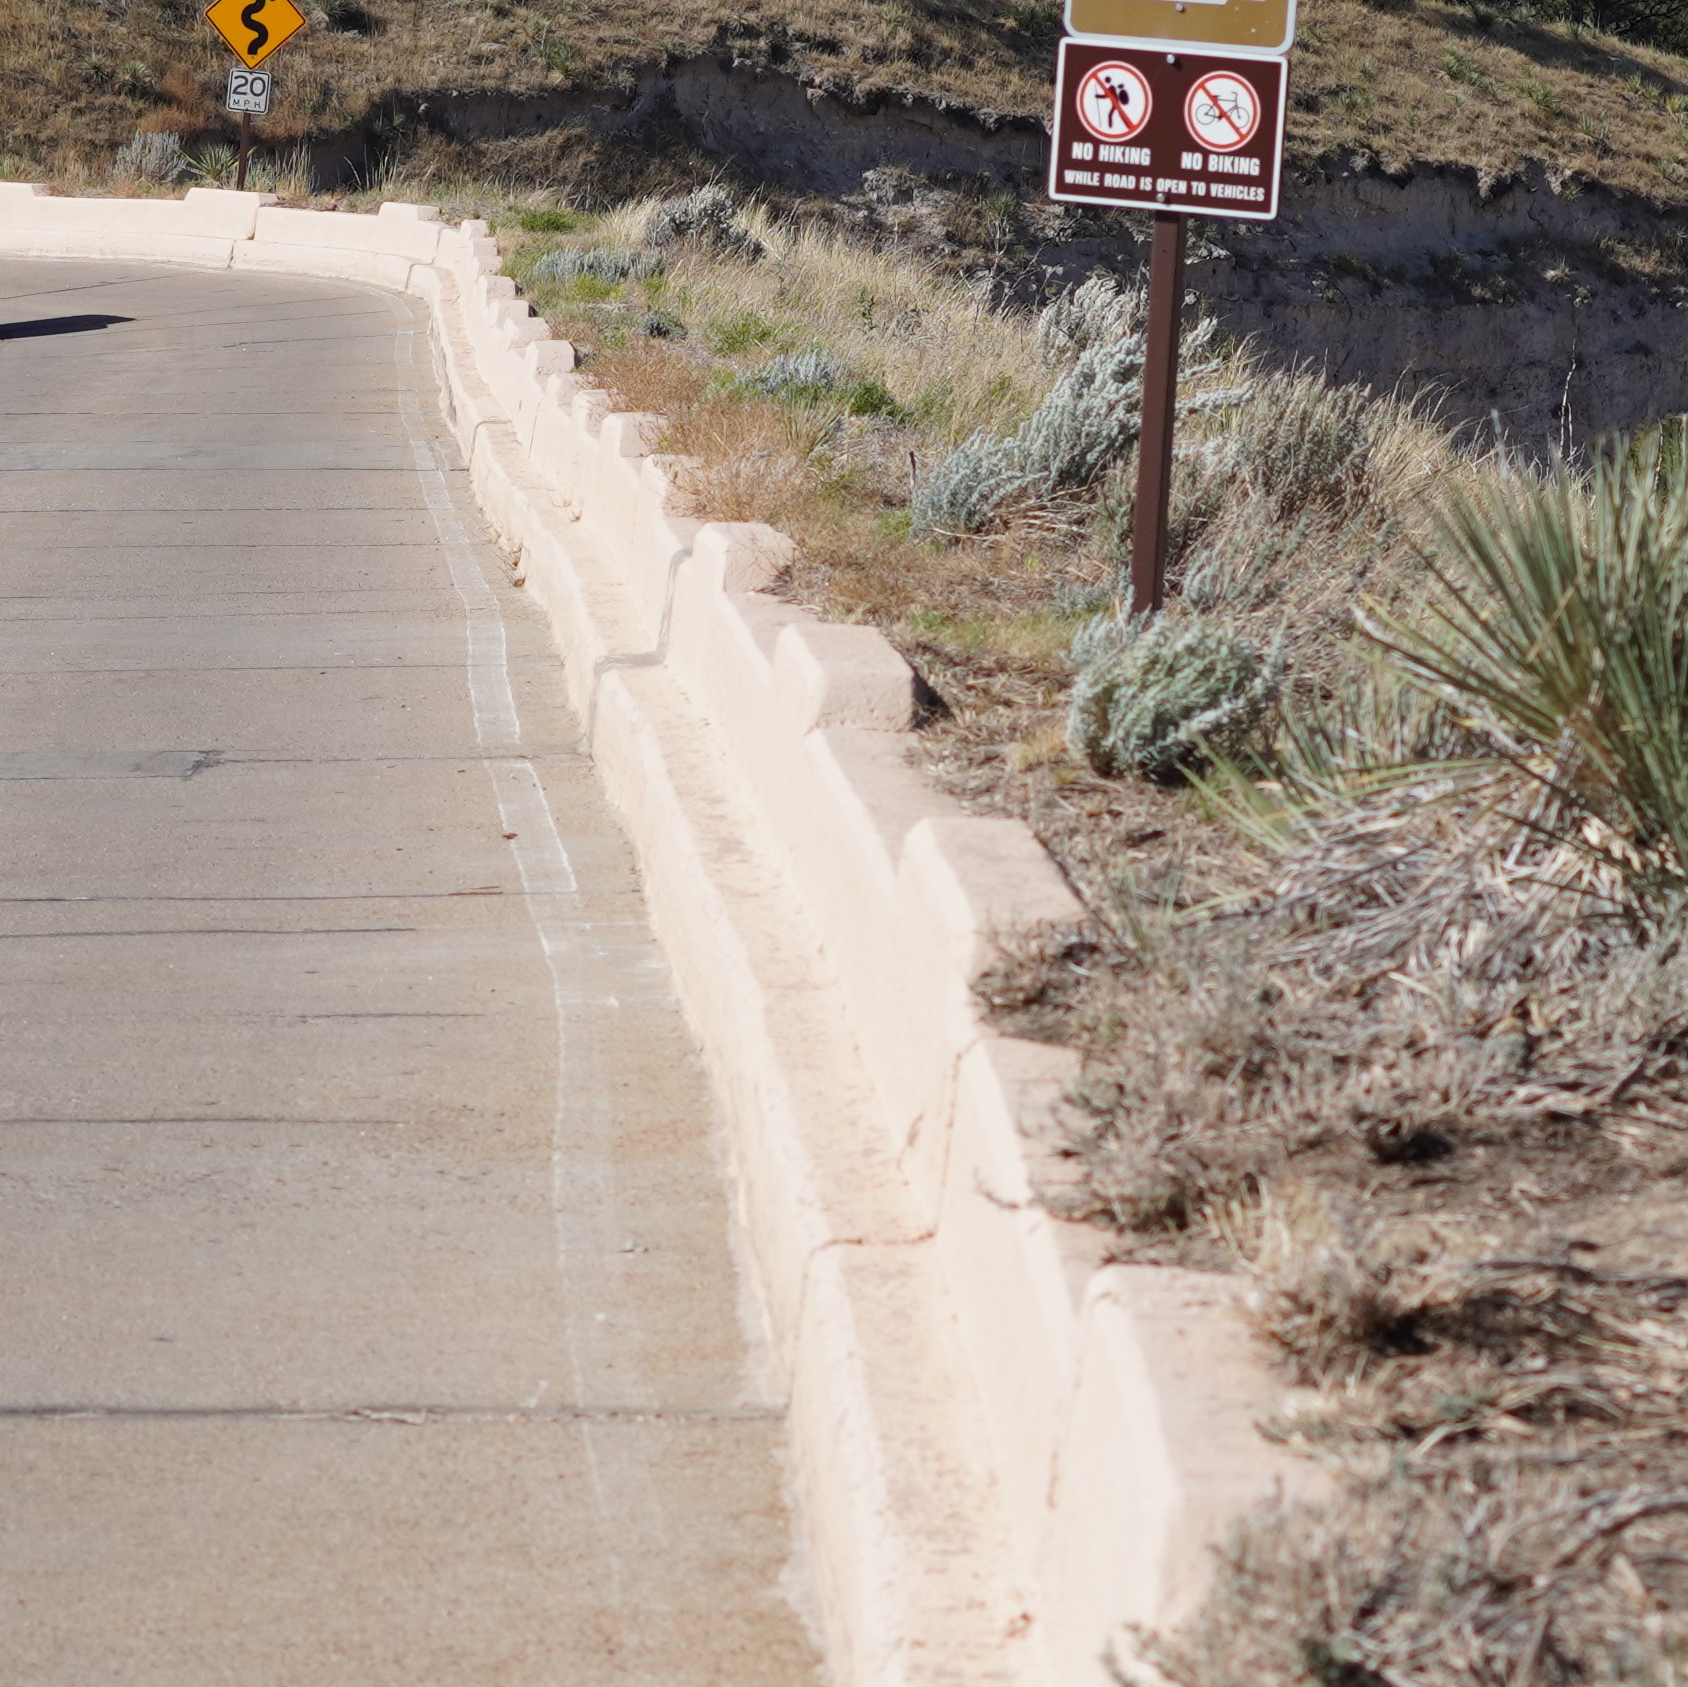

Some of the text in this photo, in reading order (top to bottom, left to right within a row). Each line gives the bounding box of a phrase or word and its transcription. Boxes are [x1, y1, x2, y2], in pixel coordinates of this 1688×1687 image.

[233, 75, 266, 97] 20
[1072, 142, 1151, 165] NO HIKING
[1181, 151, 1260, 176] NO BIKING
[1064, 169, 1265, 202] WHILE ROAD IS OPEN TO VEHICLES
